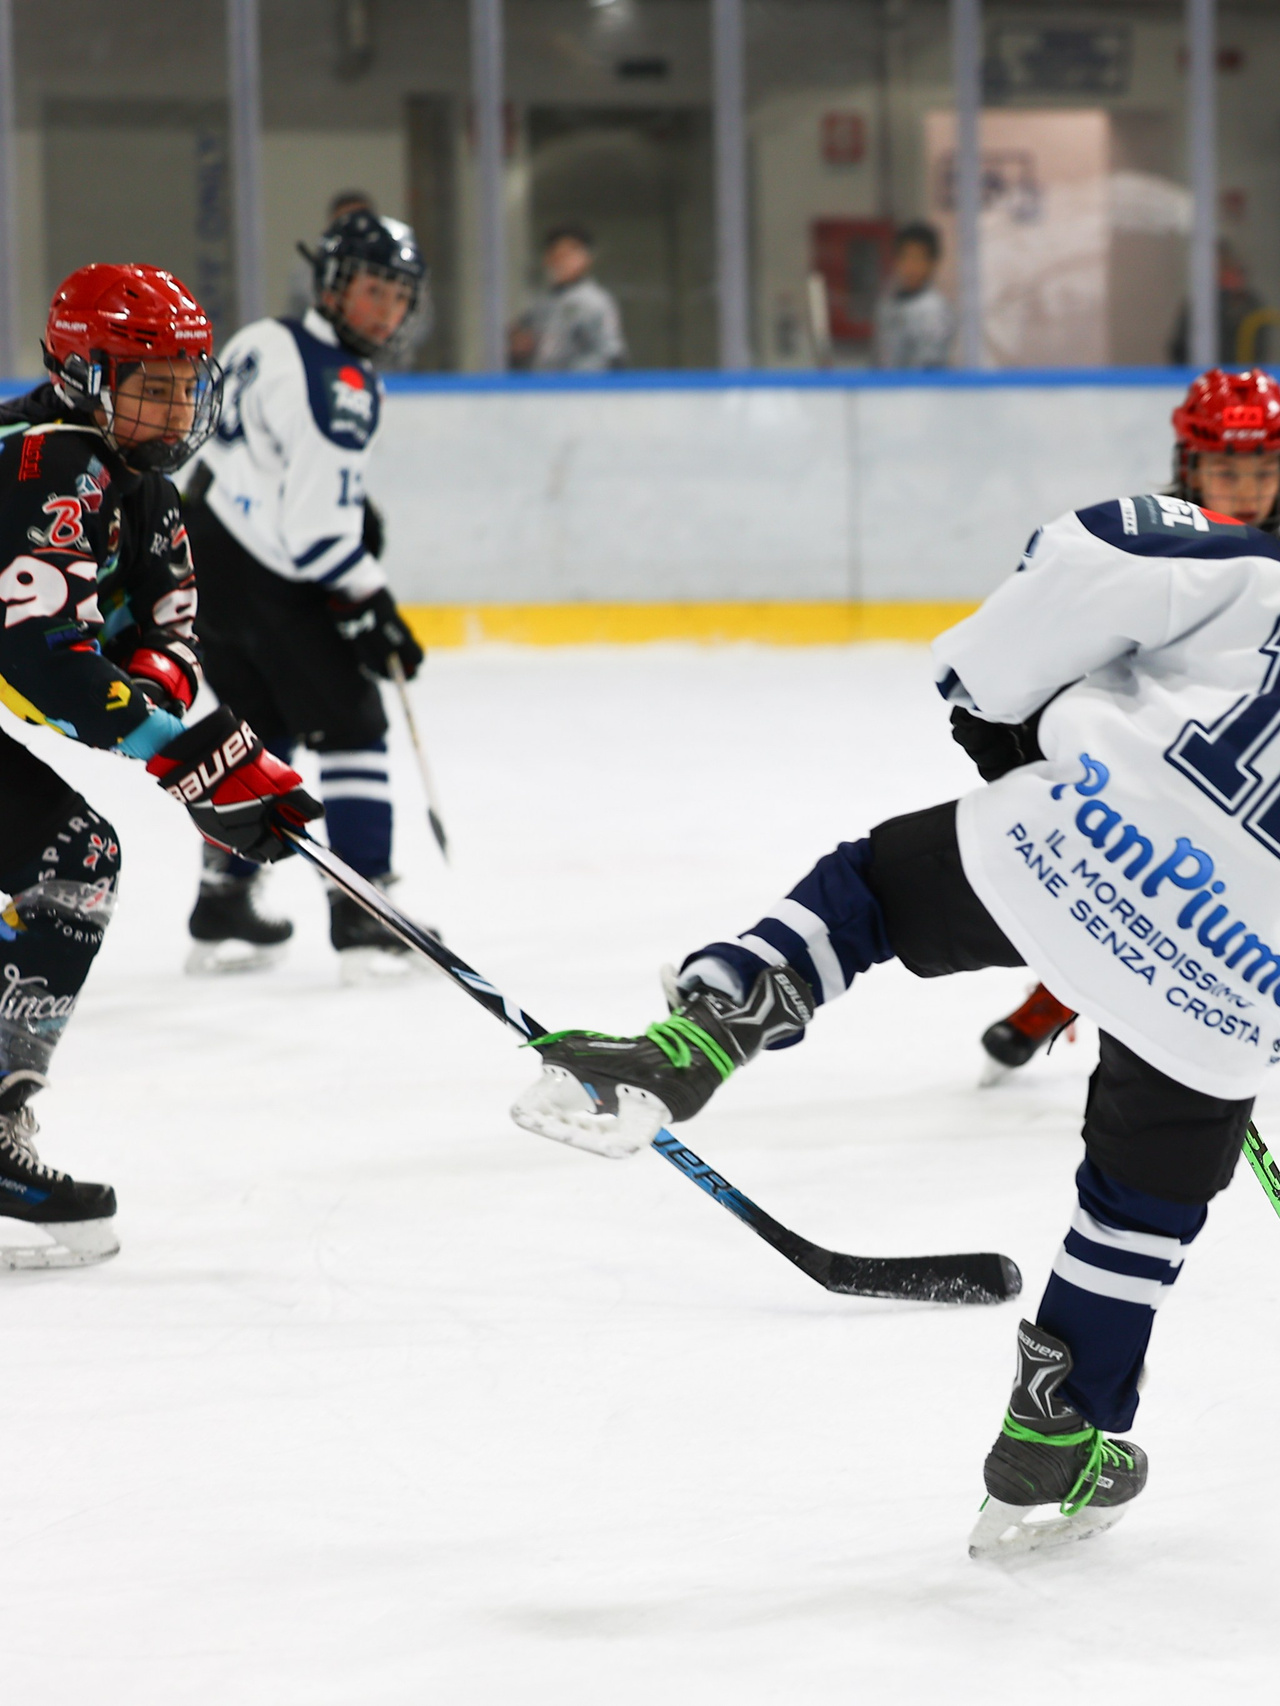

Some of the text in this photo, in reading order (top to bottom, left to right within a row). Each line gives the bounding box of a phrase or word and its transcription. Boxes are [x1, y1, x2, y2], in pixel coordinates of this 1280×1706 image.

[55, 320, 88, 332] BAUER
[175, 330, 207, 339] BAUER
[1045, 829, 1063, 859] IL
[1006, 822, 1260, 1046] PANE SENZA CROSTA
